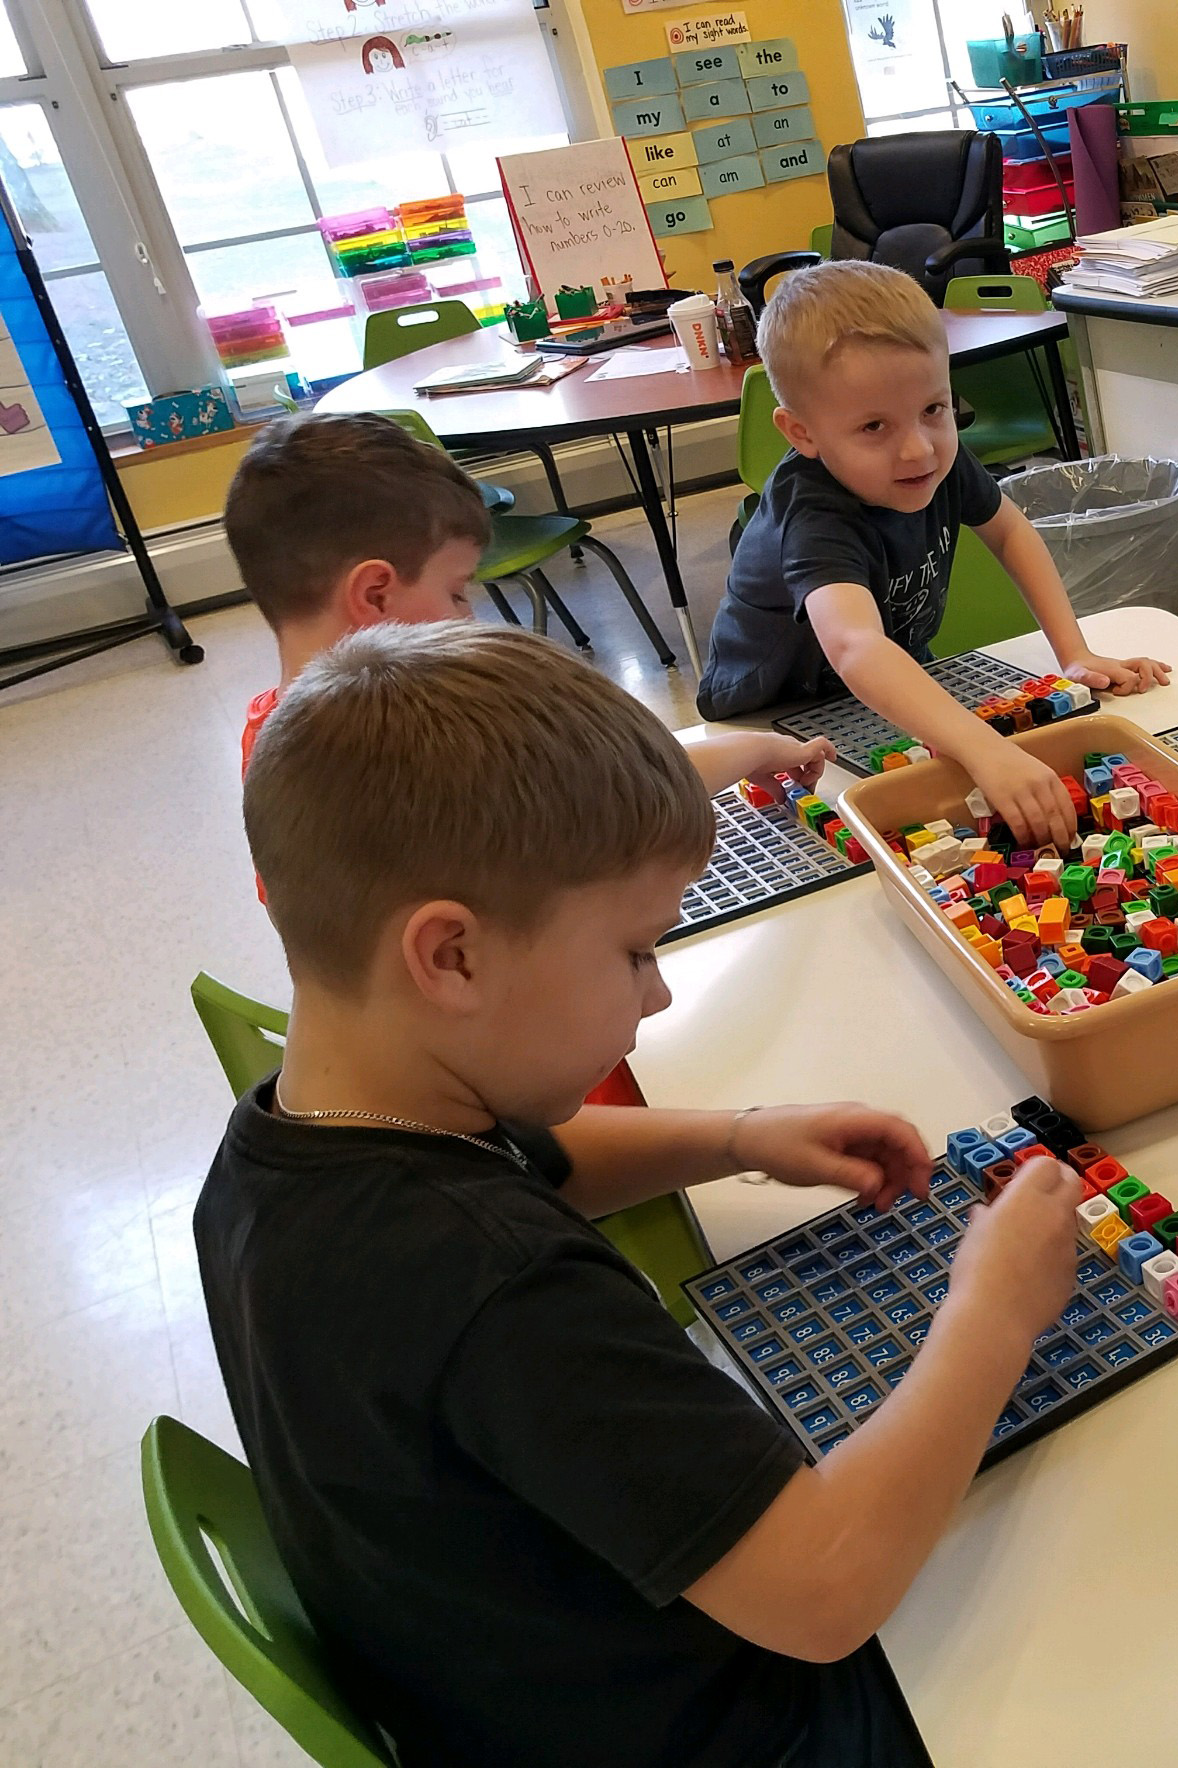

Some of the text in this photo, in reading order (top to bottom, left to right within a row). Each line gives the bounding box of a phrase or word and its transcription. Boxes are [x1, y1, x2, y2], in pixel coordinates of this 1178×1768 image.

[682, 14, 736, 33] I can read
[685, 34, 698, 45] my
[703, 28, 724, 42] sight
[695, 57, 723, 71] see
[756, 48, 783, 65] the
[633, 70, 644, 86] I
[330, 90, 364, 114] Step
[438, 68, 475, 88] letter
[771, 82, 789, 97] to
[709, 94, 720, 106] a
[636, 110, 661, 127] my
[773, 117, 790, 130] an
[717, 133, 732, 149] at
[644, 145, 674, 162] like
[779, 149, 809, 169] and
[652, 174, 678, 190] can
[719, 170, 740, 184] am
[519, 171, 627, 208] I can review
[521, 200, 613, 236] how to write
[665, 210, 686, 228] go
[550, 230, 599, 253] numbers
[1063, 1308, 1086, 1325] 38
[1098, 1287, 1121, 1305] 28
[1144, 1328, 1168, 1347] 30
[853, 1327, 875, 1344] 75
